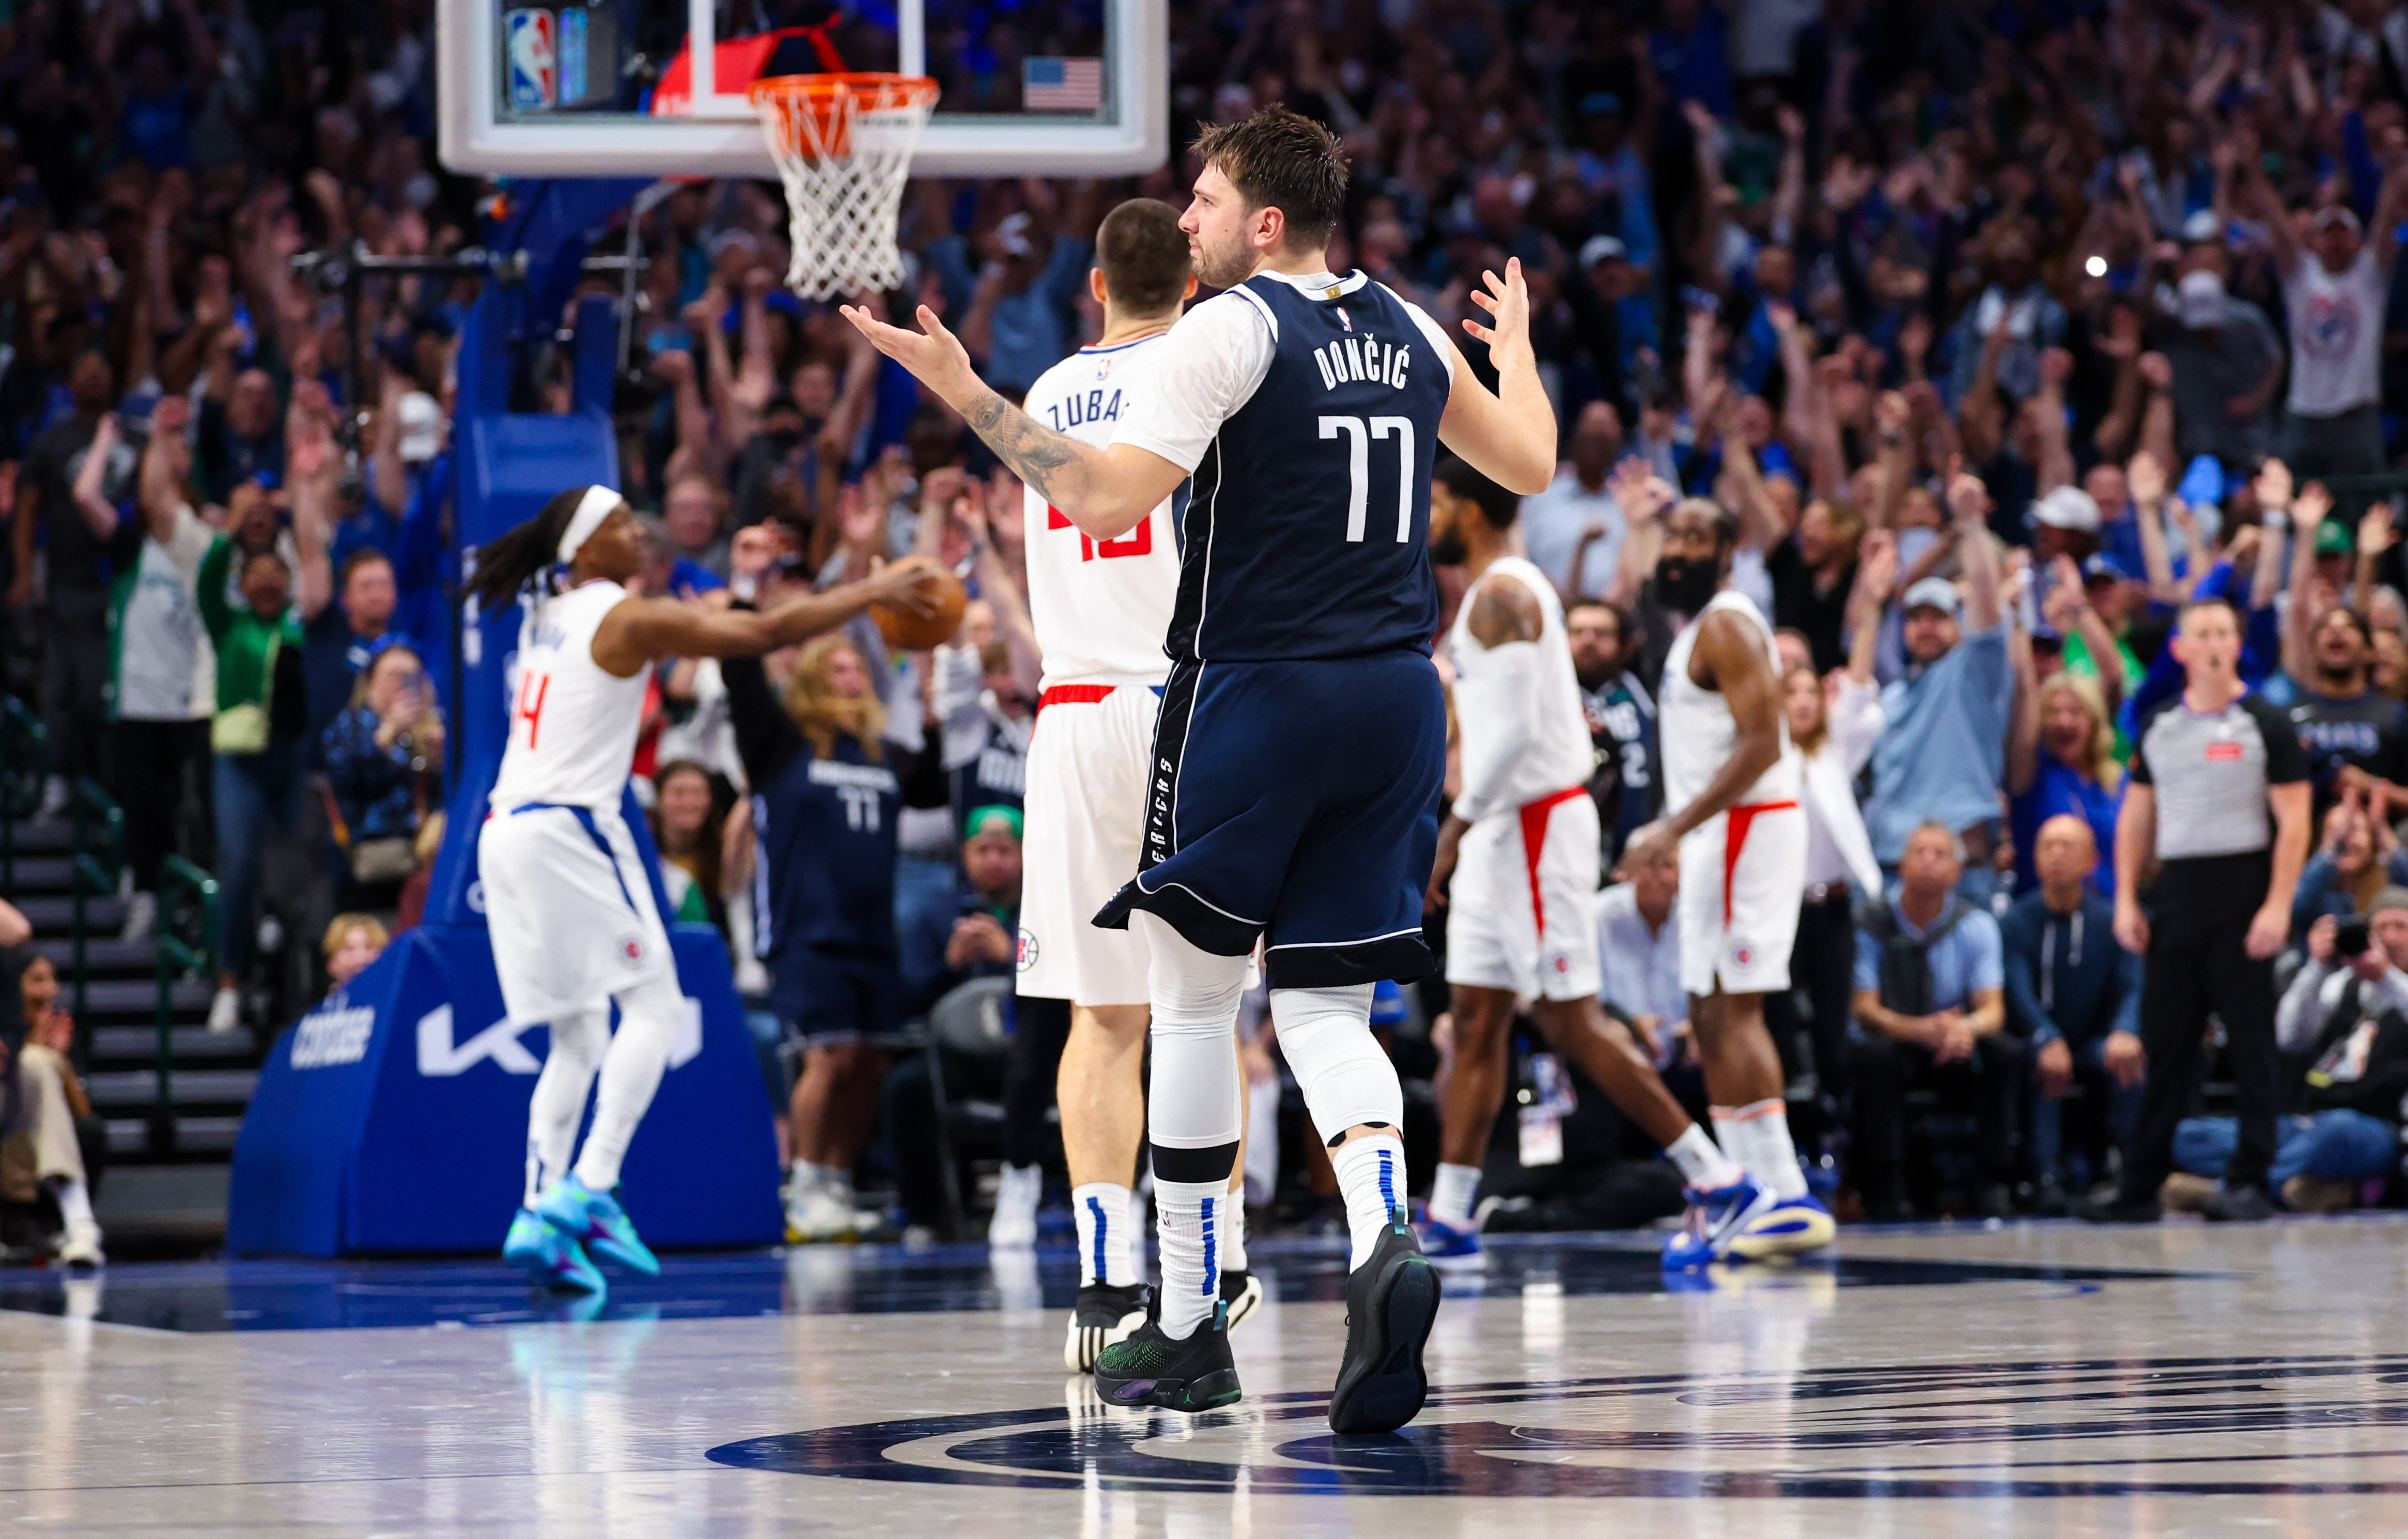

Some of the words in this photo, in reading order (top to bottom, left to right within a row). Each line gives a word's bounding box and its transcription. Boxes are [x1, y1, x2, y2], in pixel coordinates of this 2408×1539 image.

[1313, 333, 1410, 391] DONČIĆ
[1047, 388, 1130, 433] ZUBA
[1318, 415, 1415, 543] 77
